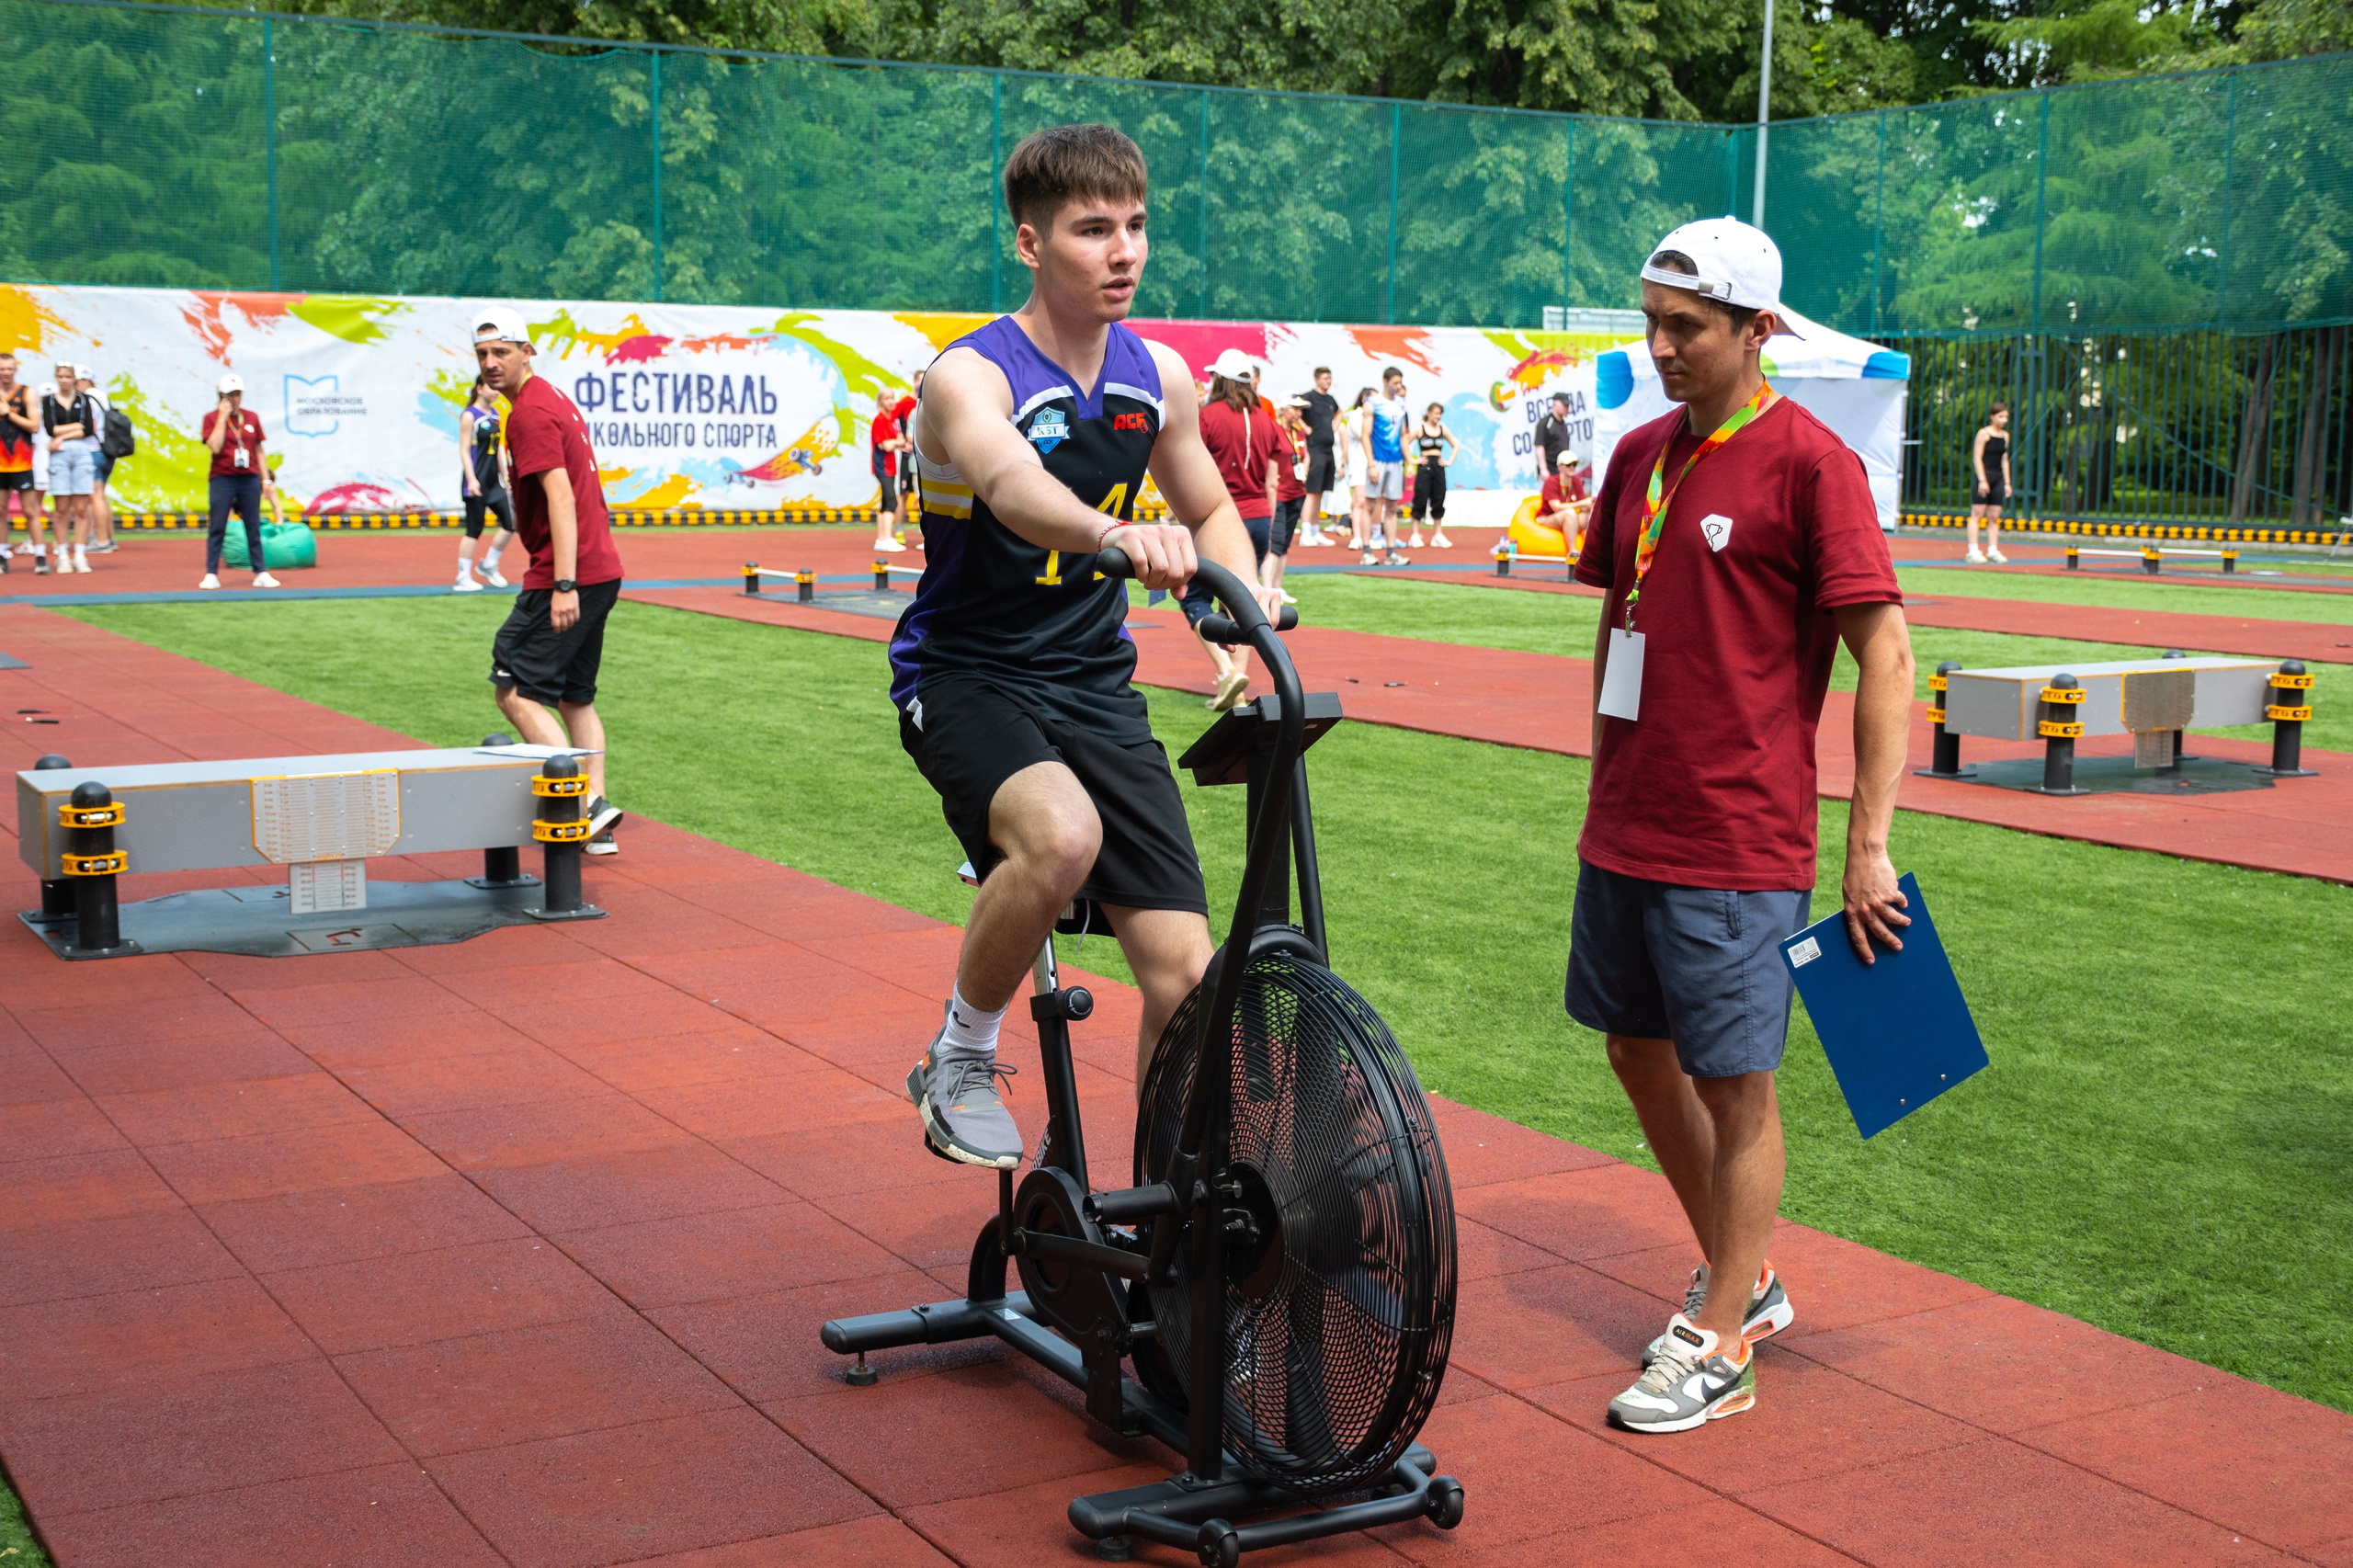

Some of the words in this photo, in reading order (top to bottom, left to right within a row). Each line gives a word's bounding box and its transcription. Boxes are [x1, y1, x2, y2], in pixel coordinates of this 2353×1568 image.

[574, 370, 778, 415] ФЕСТИВАЛЬ
[1526, 391, 1586, 424] ВСЕДА
[703, 422, 778, 449] СПОРТА
